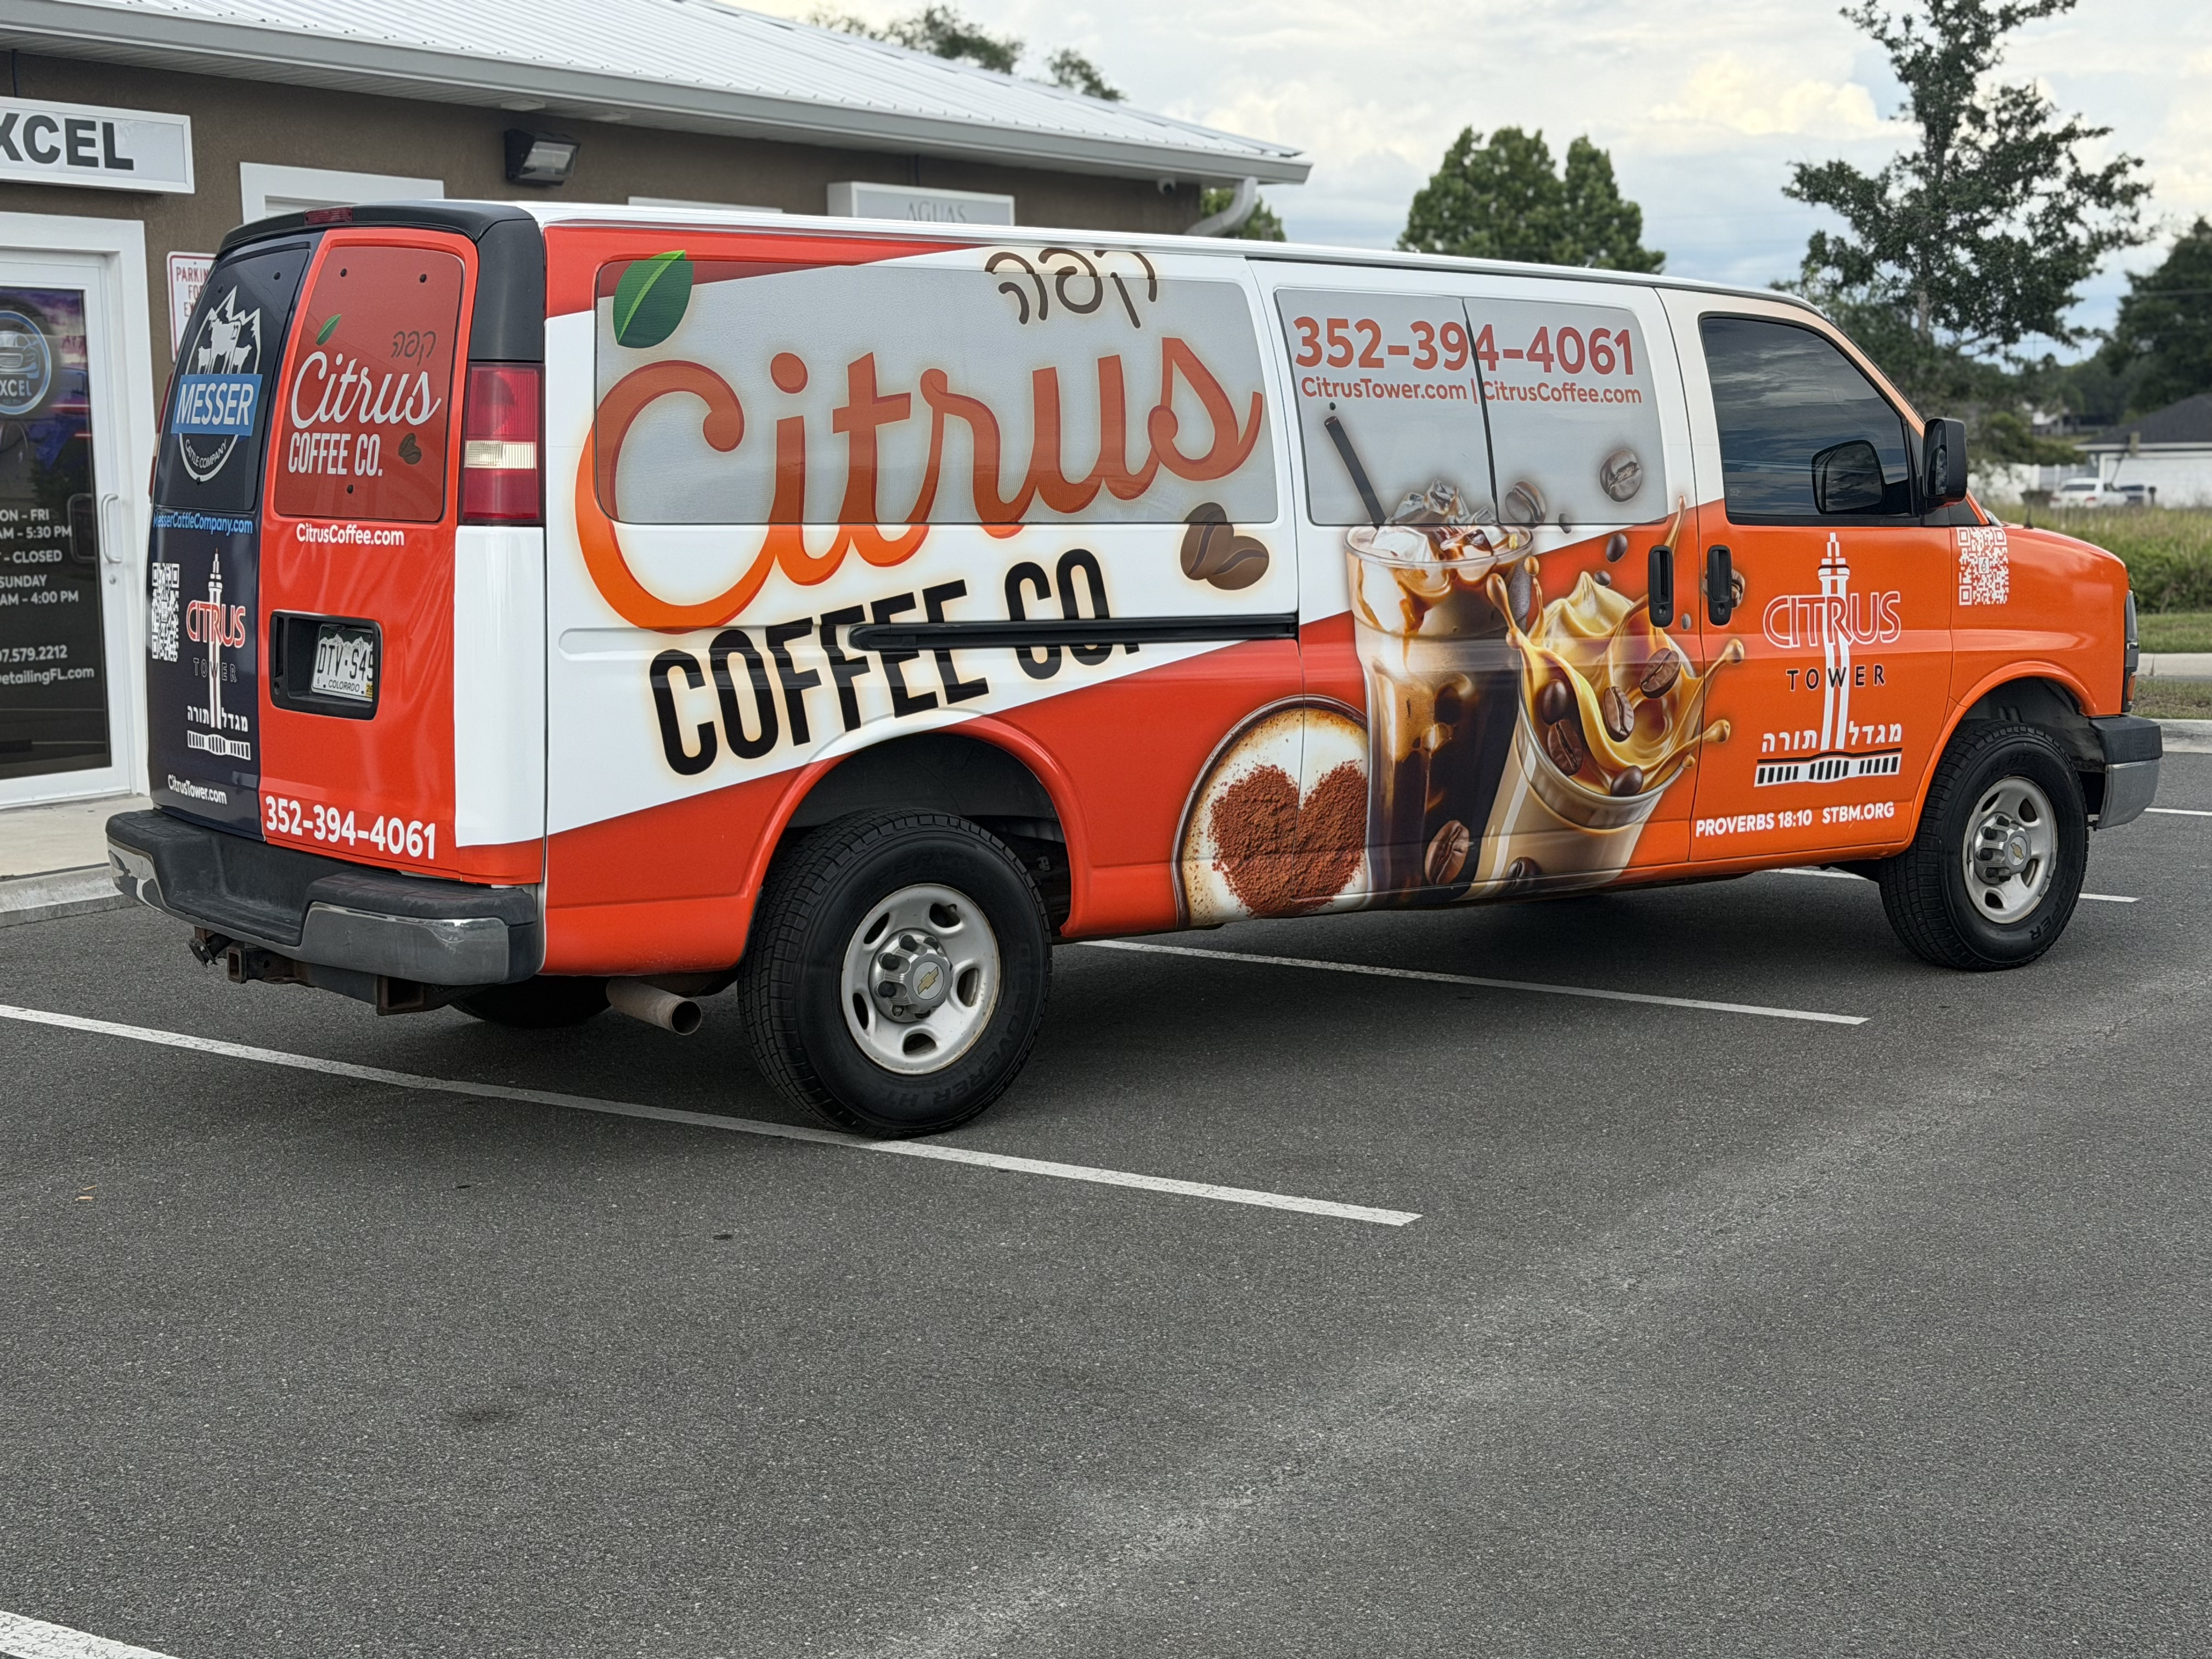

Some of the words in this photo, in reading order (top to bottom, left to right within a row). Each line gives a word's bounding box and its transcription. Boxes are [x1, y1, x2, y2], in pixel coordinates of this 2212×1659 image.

[0, 112, 134, 171] XCEL
[176, 266, 209, 282] PARKIN
[188, 284, 204, 301] FO
[1293, 317, 1633, 375] 352-394-4061
[0, 379, 32, 397] XCEL
[291, 351, 442, 429] Citrus
[1301, 376, 1468, 400] CitrusTower.com
[1483, 381, 1642, 404] CitrusCoffee.com
[176, 382, 254, 426] MESSER
[185, 439, 200, 467] CATTLE
[199, 438, 227, 469] COMPANY
[288, 432, 352, 476] COFFEE
[354, 433, 383, 477] CO.
[575, 337, 1263, 635] Citrus
[0, 509, 19, 522] ON
[30, 508, 49, 521] FRI
[0, 527, 14, 539] M
[26, 526, 52, 539] 5:30
[54, 524, 72, 537] PM
[296, 522, 405, 546] CitrusCoffee.com
[13, 549, 63, 564] CLOSED
[0, 574, 48, 589] SUNDAY
[30, 590, 58, 604] 4:00
[60, 590, 79, 603] PM
[186, 600, 246, 648] CITRUS
[1763, 591, 1901, 648] CITRUS
[0, 644, 68, 663] 7.579.2212
[328, 679, 360, 692] COLORADO
[649, 579, 990, 776] COFFEE
[1786, 664, 1886, 691] TOWER
[168, 774, 228, 805] CitrusTower.com
[266, 795, 436, 860] 352-394-4061
[1696, 812, 1775, 837] PROVERBS
[1778, 808, 1813, 828] 18:10
[1822, 801, 1895, 825] STBM.ORG
